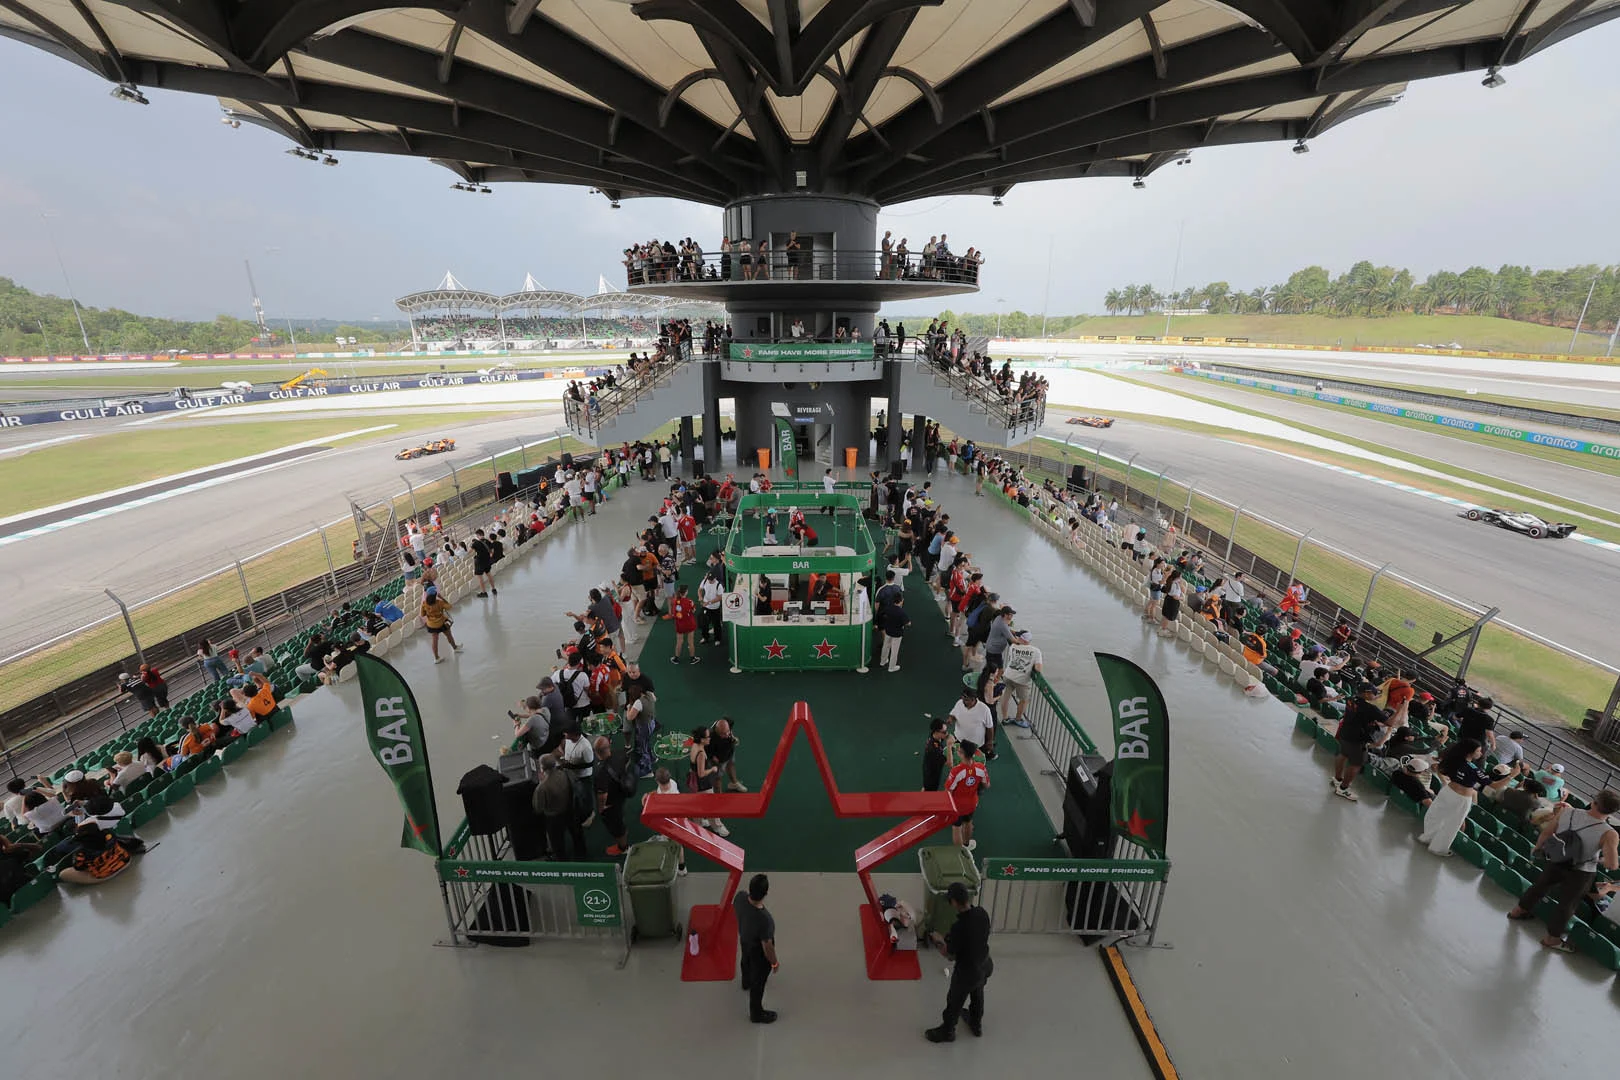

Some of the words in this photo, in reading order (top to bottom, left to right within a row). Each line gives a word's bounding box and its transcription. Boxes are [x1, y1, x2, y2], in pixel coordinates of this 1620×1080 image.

[349, 384, 380, 393] GULF
[382, 382, 400, 391] AIR
[419, 379, 446, 387] GULF
[448, 377, 464, 385] AIR
[269, 389, 303, 400] GULF
[306, 387, 329, 397] AIR
[175, 398, 218, 410] GULF
[219, 394, 246, 405] AIR
[1373, 403, 1399, 414] aramco
[60, 408, 109, 421] GULF
[115, 404, 145, 417] AIR
[1405, 410, 1434, 421] aramco
[0, 415, 23, 428] IR
[1441, 417, 1474, 429] aramco
[1483, 425, 1522, 438] aramco
[781, 430, 793, 451] BAR
[1533, 433, 1578, 449] aramco
[792, 561, 810, 569] BAR
[375, 696, 413, 766] BAR
[1117, 696, 1150, 760] BAR
[586, 895, 608, 905] 21+
